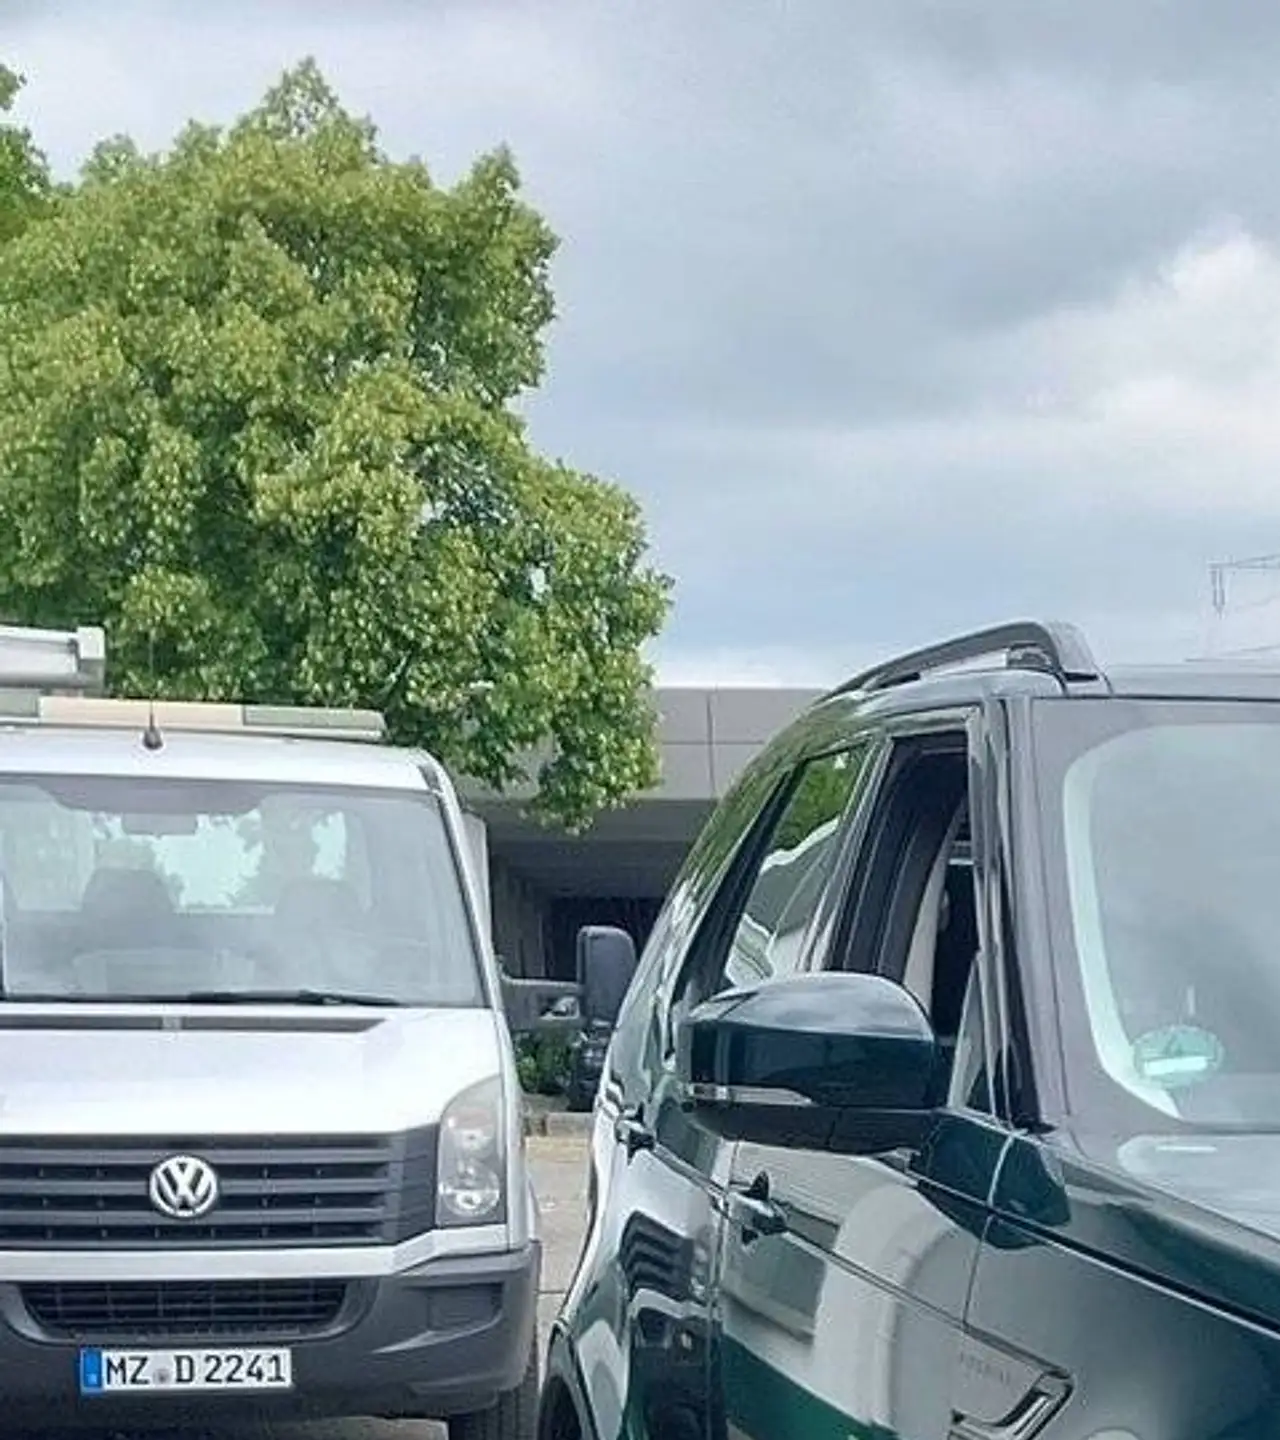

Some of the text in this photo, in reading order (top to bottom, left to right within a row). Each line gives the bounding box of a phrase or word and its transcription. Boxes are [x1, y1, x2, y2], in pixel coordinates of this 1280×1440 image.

[105, 1355, 149, 1386] MZ
[174, 1355, 195, 1385] D
[203, 1354, 287, 1384] 2241
